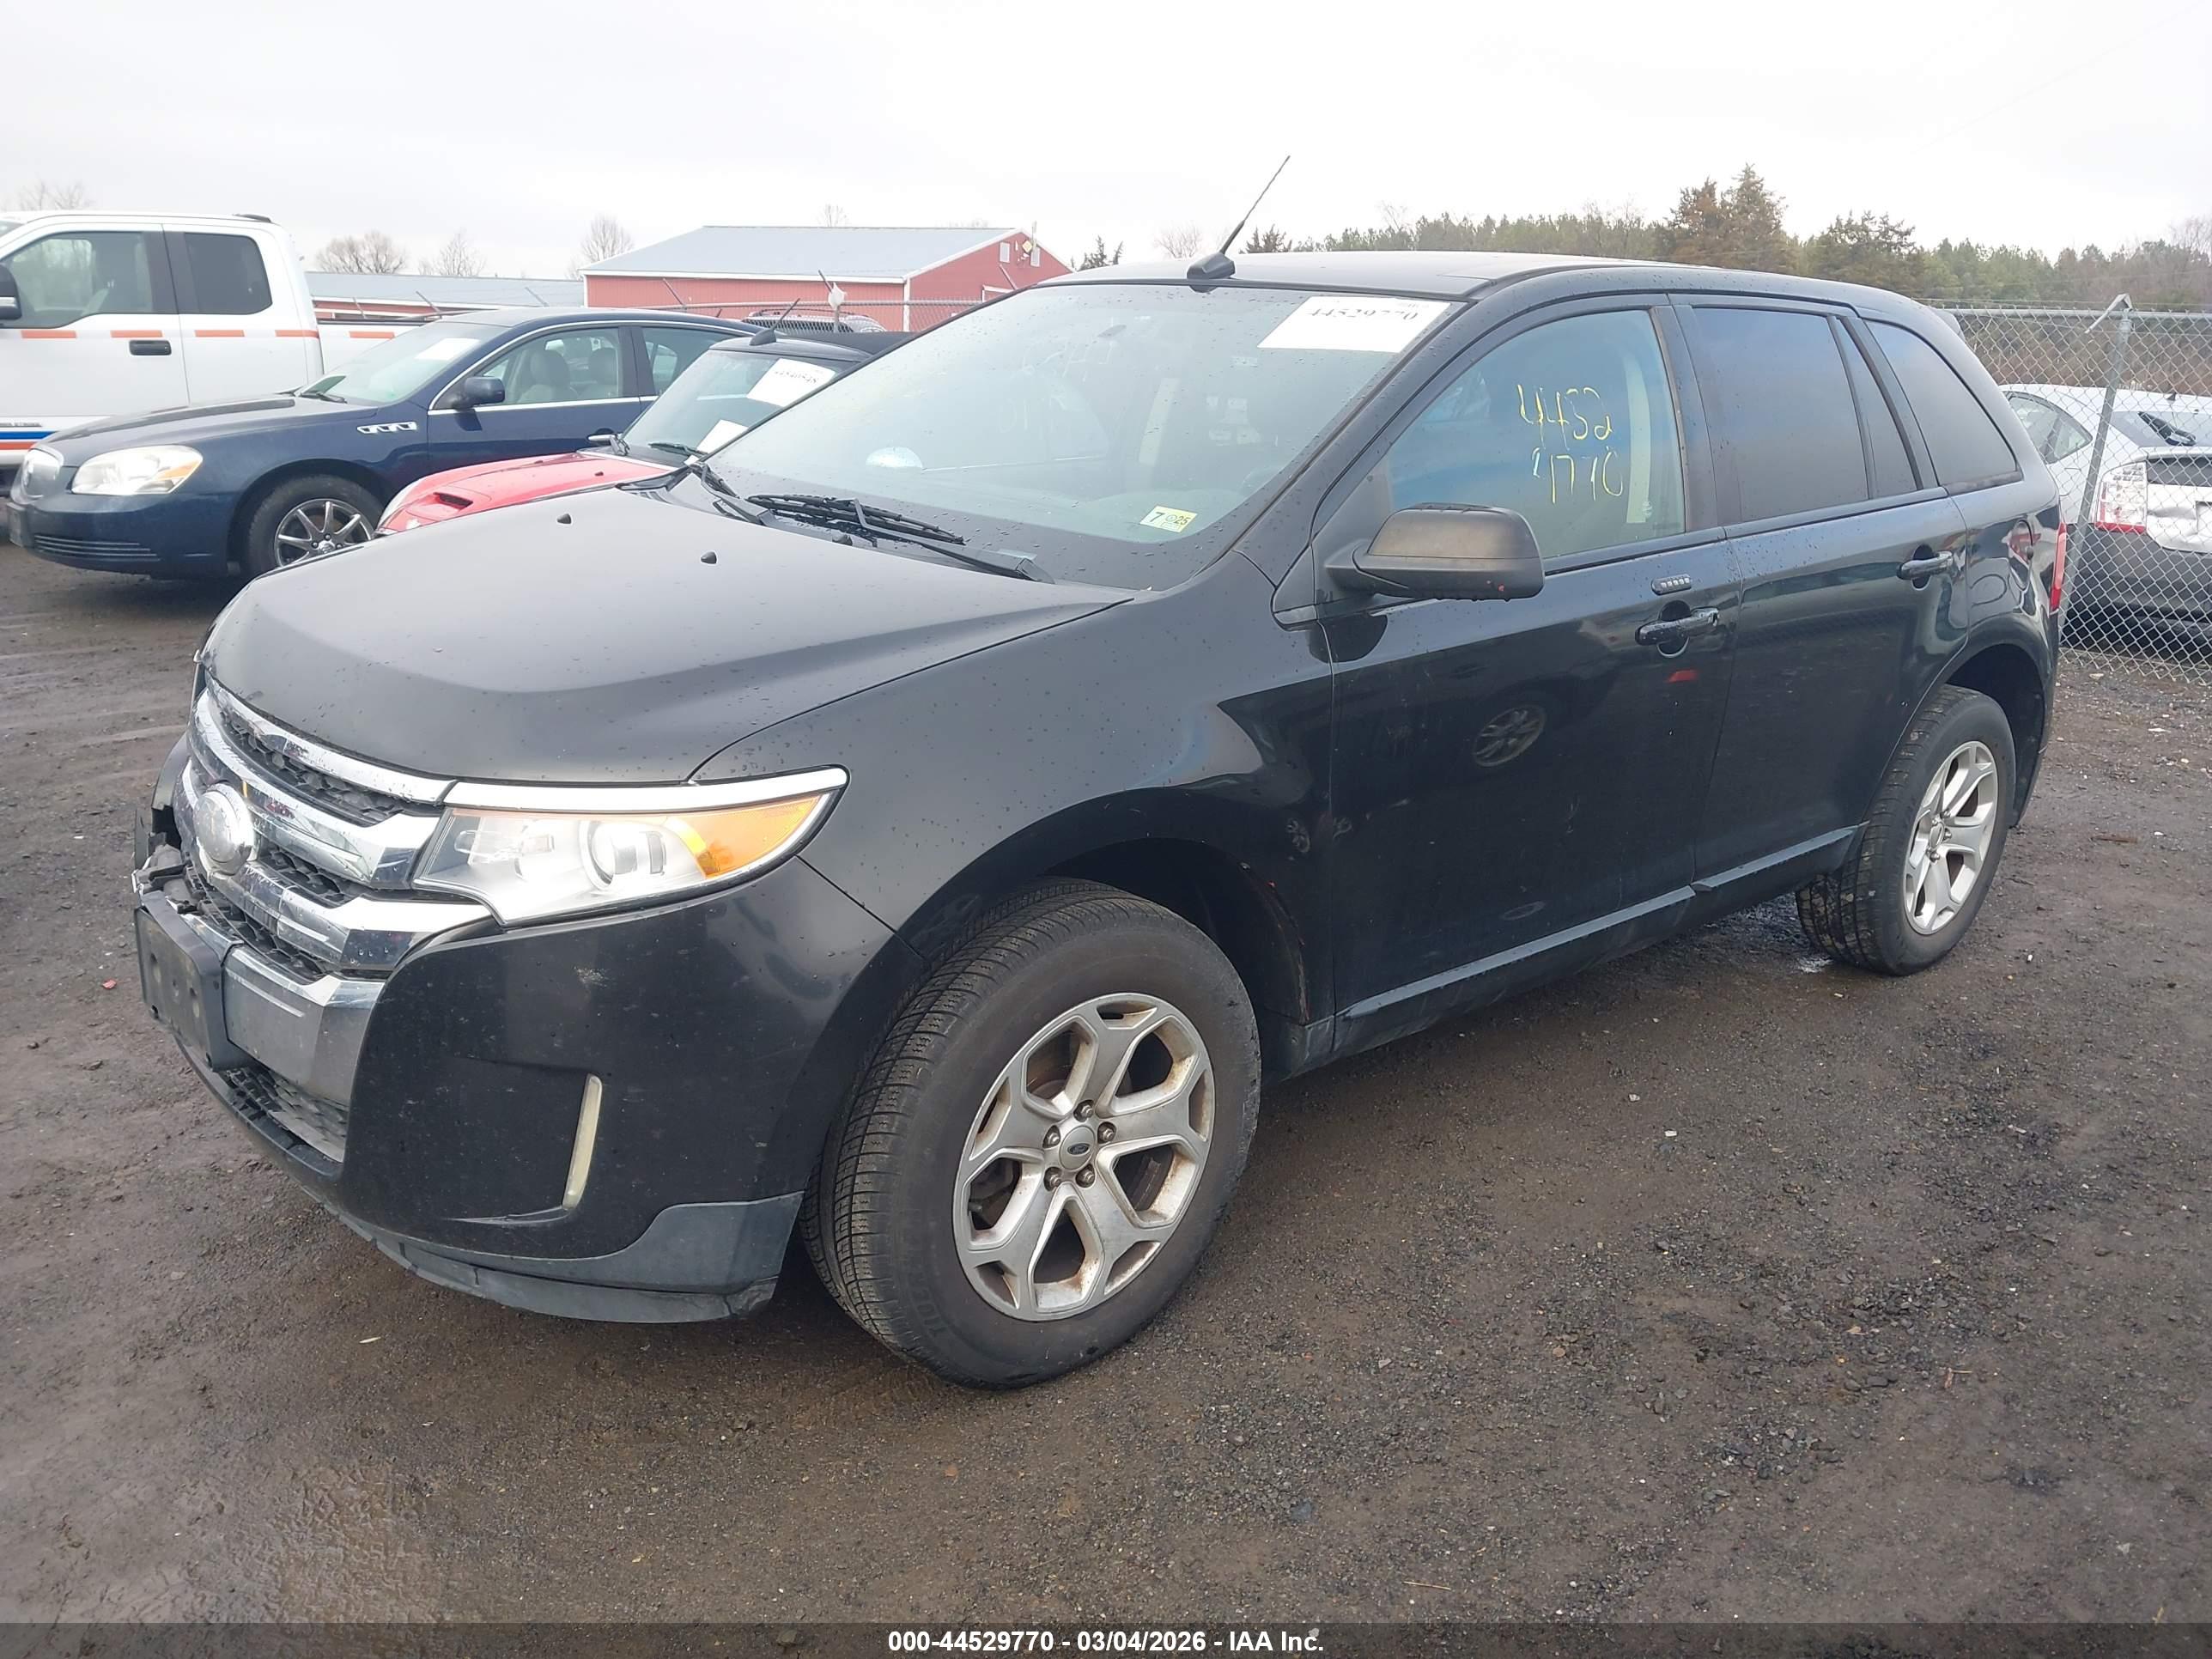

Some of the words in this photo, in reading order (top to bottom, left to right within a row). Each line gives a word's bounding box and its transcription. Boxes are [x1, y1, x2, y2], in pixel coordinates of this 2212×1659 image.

[1516, 385, 1613, 450] 4452
[1150, 512, 1165, 522] 7
[1174, 515, 1191, 525] 25
